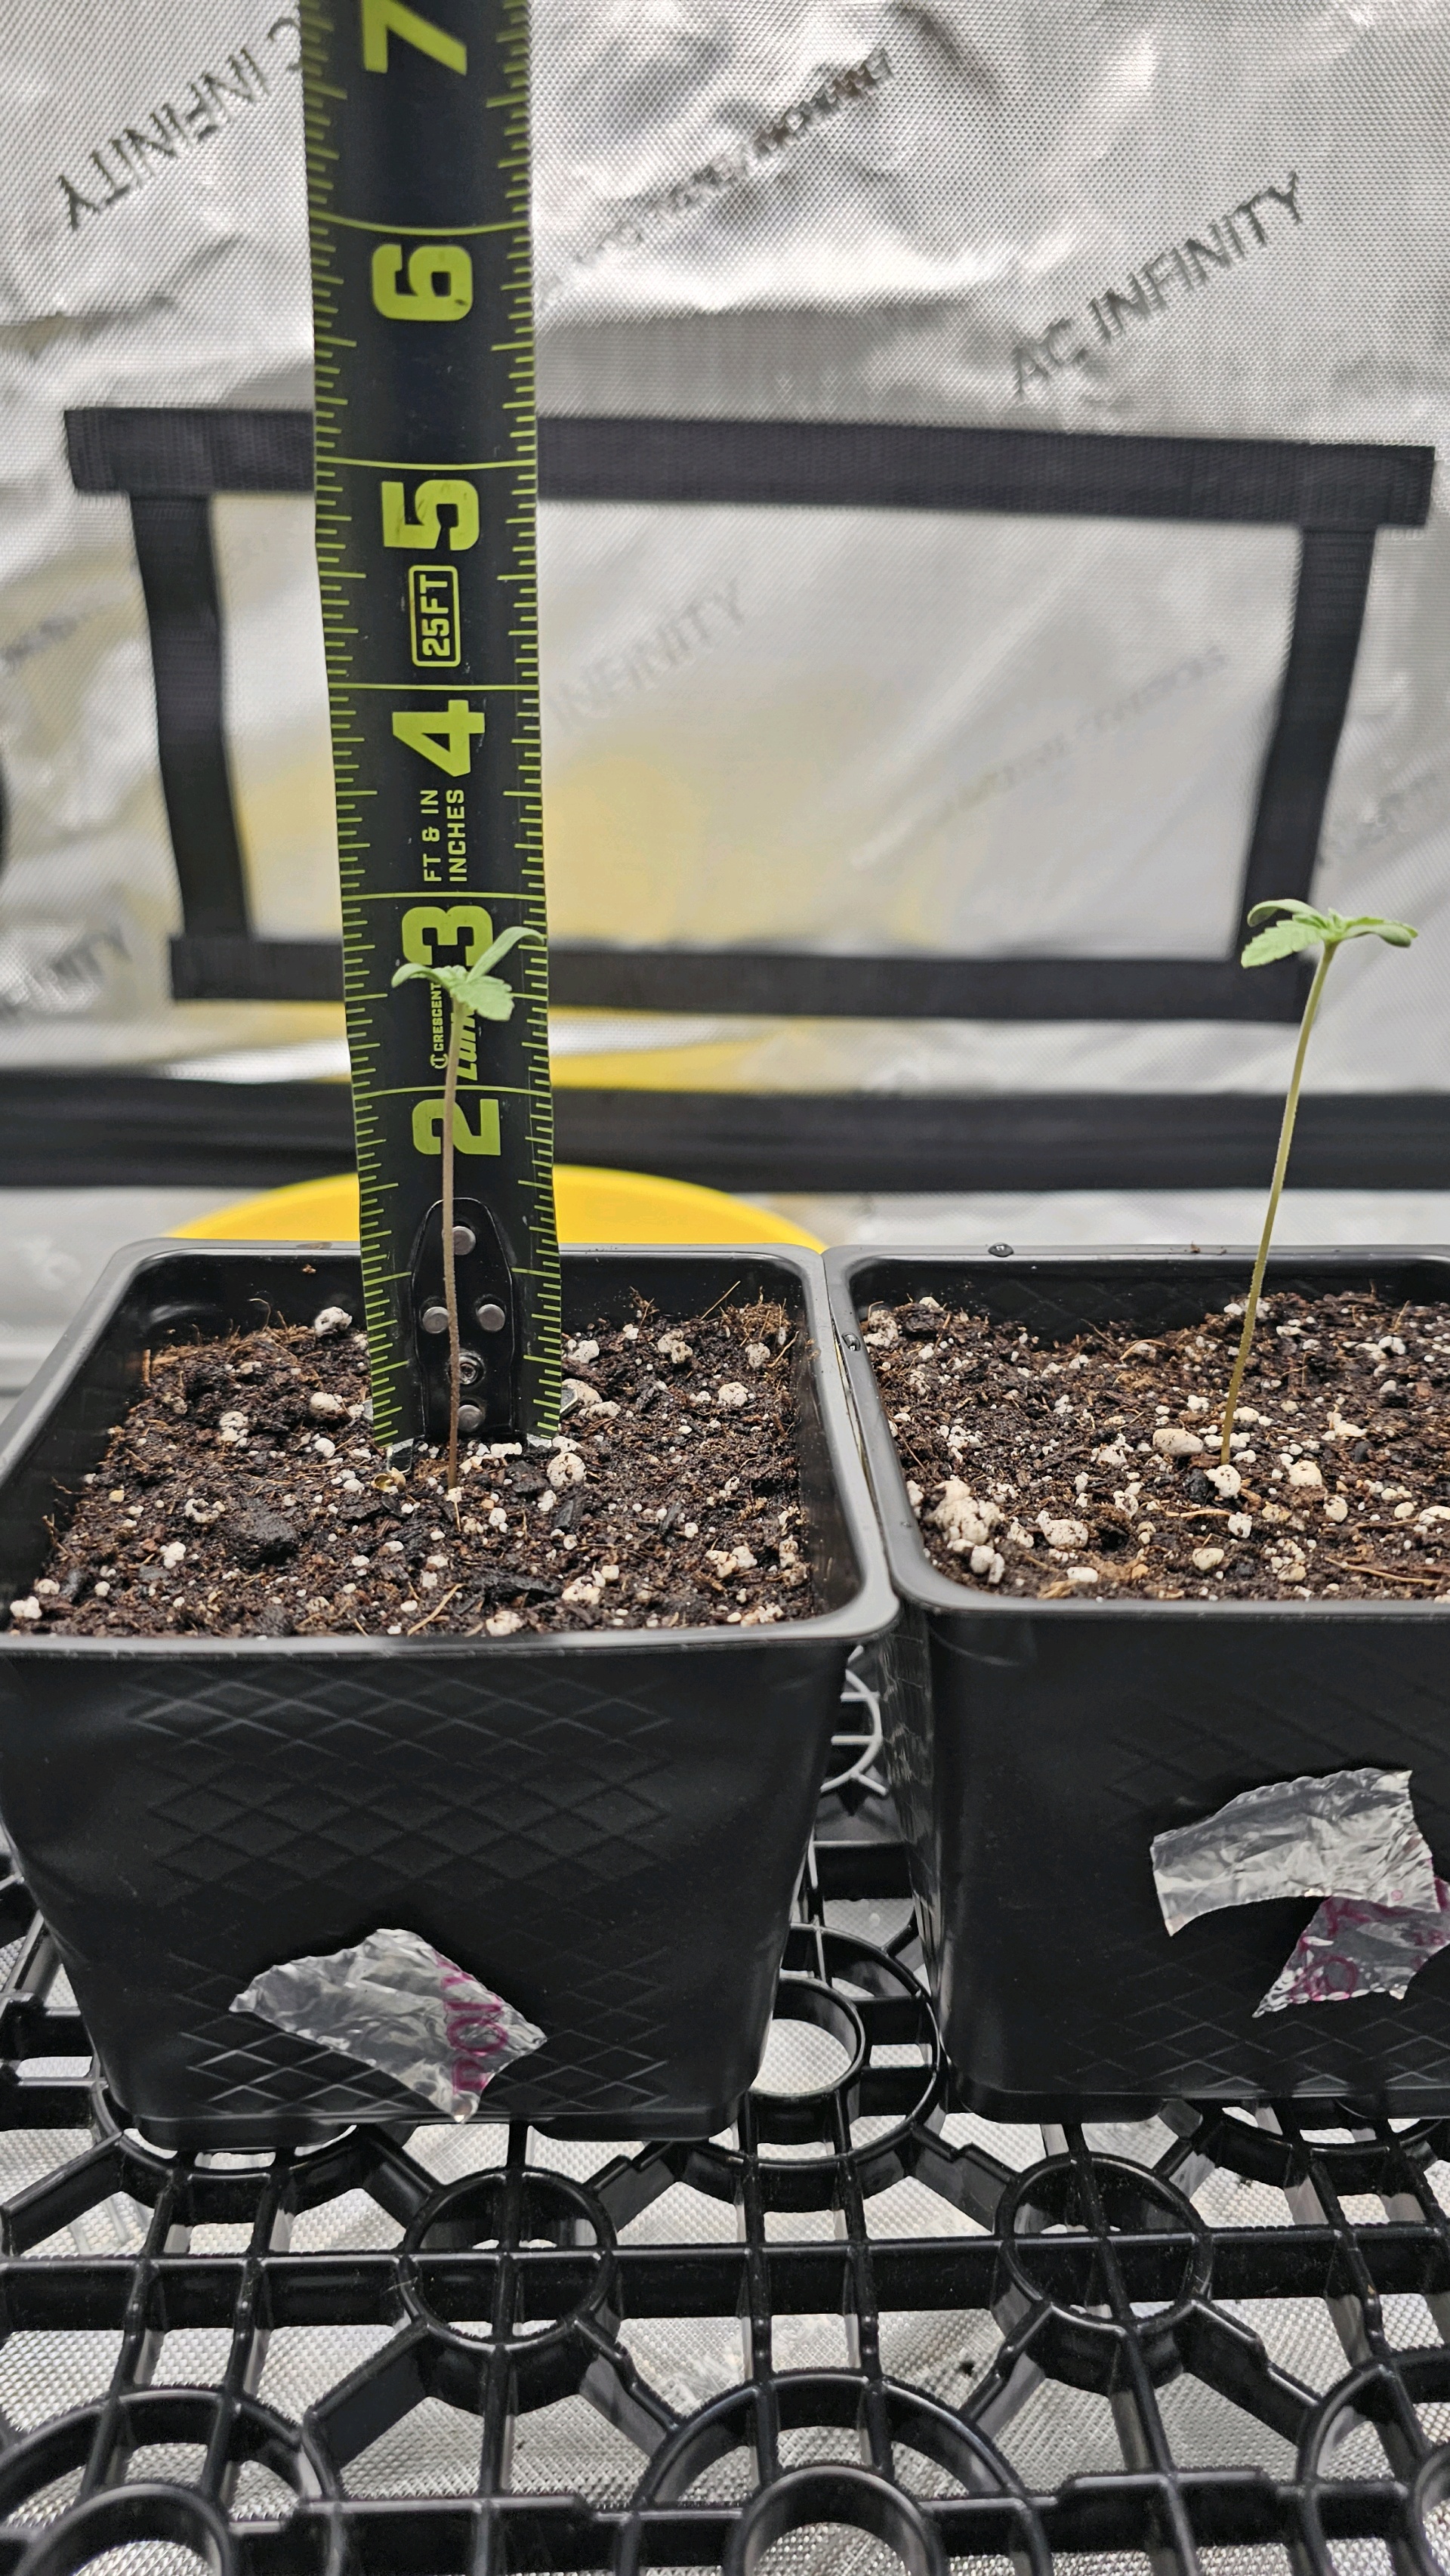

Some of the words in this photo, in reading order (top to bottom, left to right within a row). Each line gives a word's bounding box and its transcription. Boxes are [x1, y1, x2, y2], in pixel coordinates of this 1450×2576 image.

[362, 0, 467, 75] 7
[58, 47, 270, 228] INFINITY
[372, 244, 473, 321] 6
[1012, 317, 1089, 398] AC
[1088, 171, 1302, 344] INFINITY
[381, 480, 480, 551] 5
[420, 575, 450, 657] 25FT
[392, 700, 485, 777] 4
[420, 790, 439, 814] IN
[421, 826, 440, 842] &
[446, 789, 467, 882] INCHES
[423, 853, 442, 882] FT
[402, 905, 493, 967] 3
[430, 982, 444, 1052] CRESCENT
[412, 1098, 501, 1156] 2
